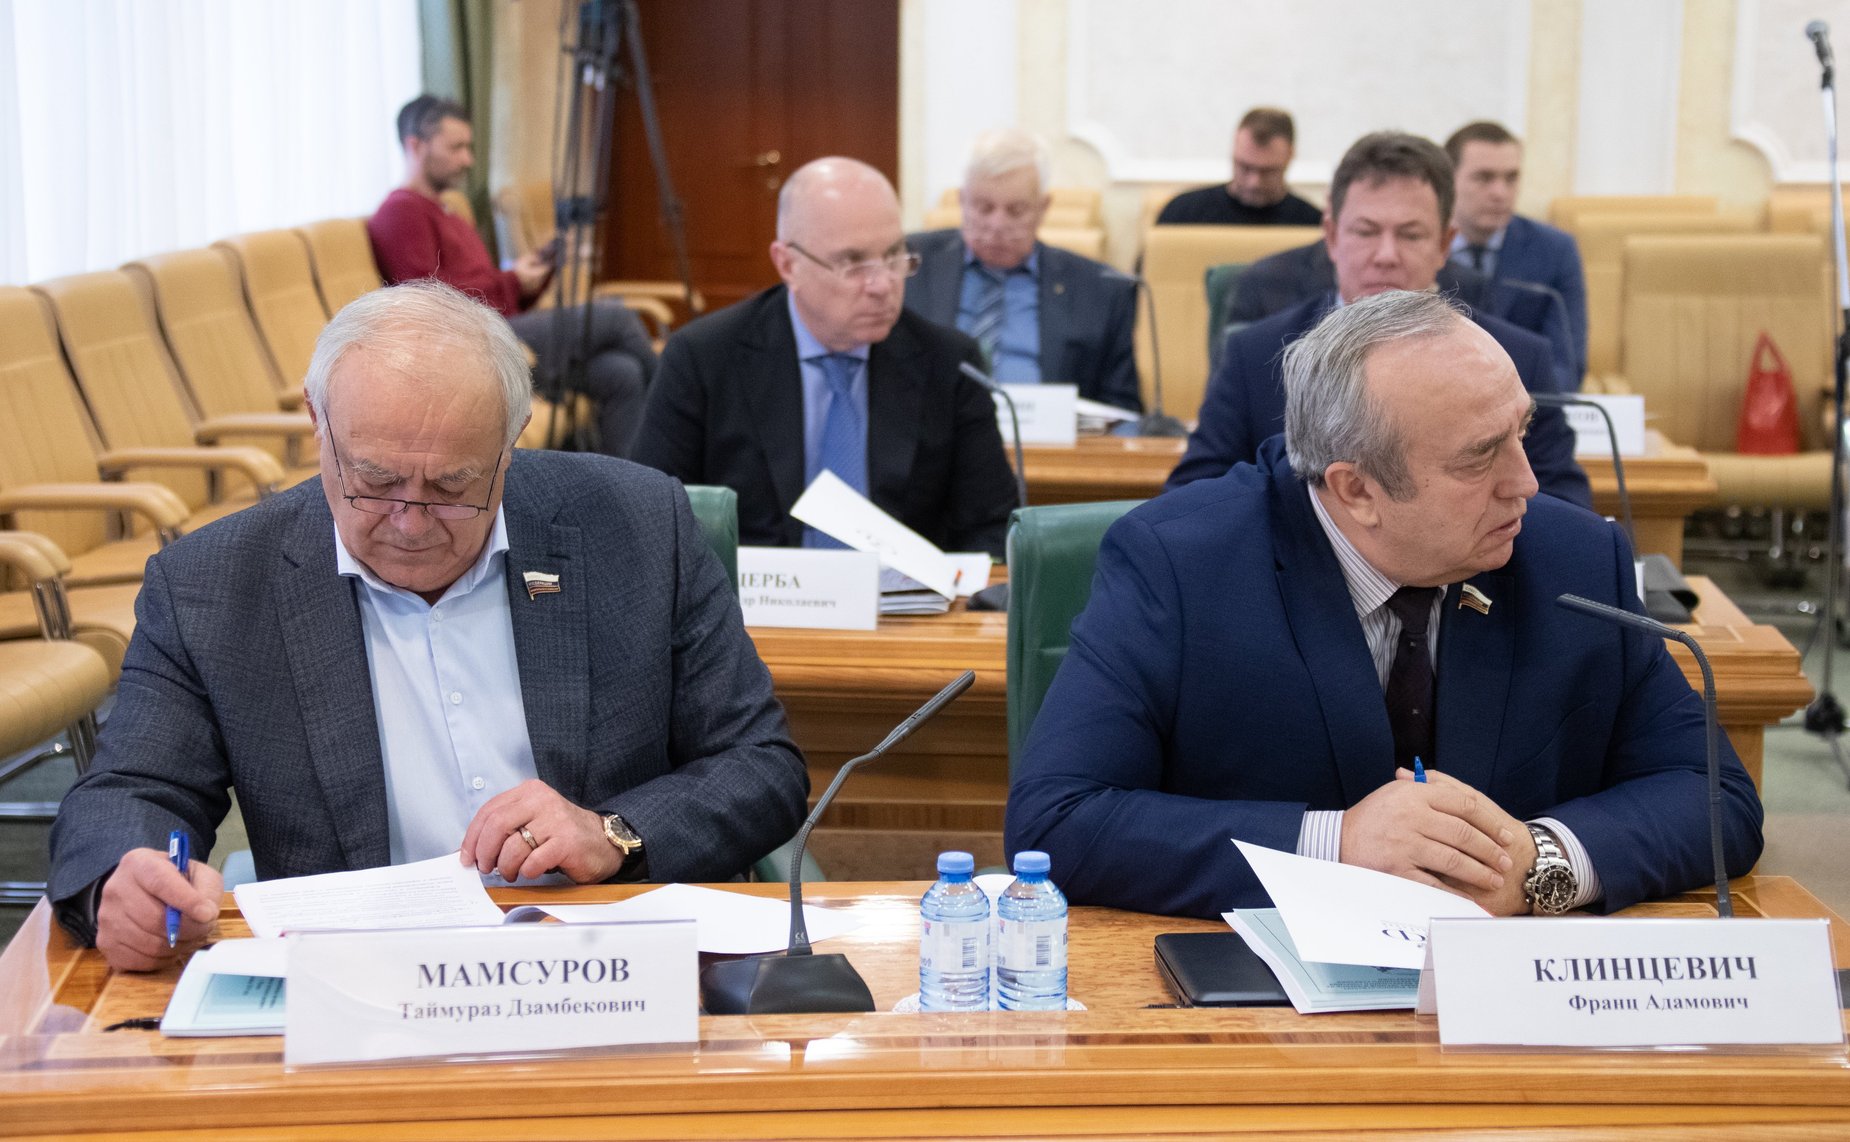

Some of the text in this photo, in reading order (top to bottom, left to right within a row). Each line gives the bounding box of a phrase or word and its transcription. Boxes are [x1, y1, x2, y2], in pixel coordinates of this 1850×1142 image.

[416, 958, 631, 989] МАМСУРОВ
[1532, 956, 1759, 985] КЛИНЦЕВИЧ
[398, 997, 647, 1022] Таймураз Дзамбекович
[1568, 994, 1749, 1015] Франц Адамович
